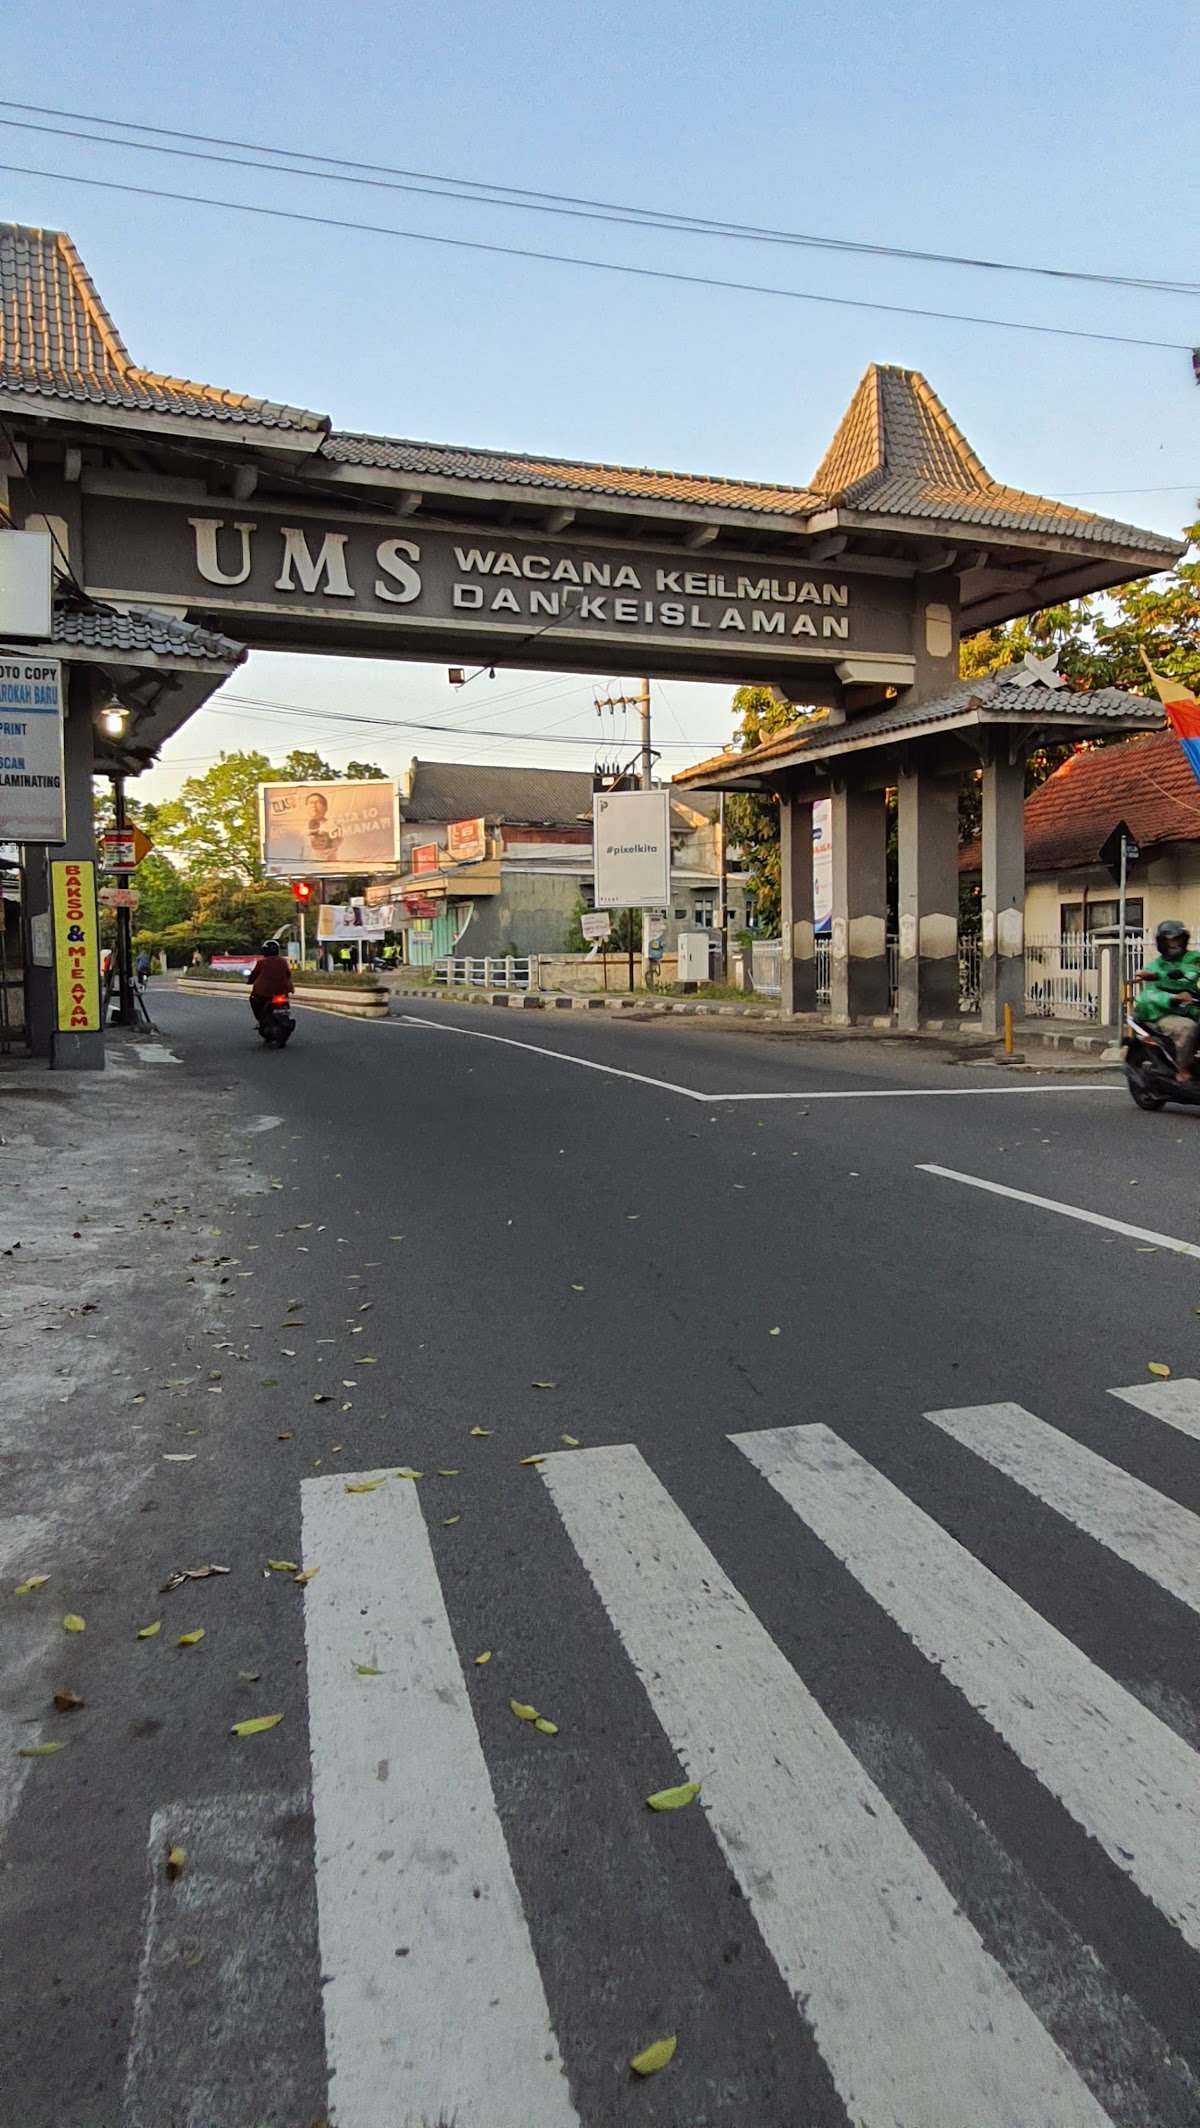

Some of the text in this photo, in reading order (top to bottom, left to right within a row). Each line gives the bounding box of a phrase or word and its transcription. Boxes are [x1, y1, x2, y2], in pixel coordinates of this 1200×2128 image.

[188, 517, 422, 603] UMS
[453, 547, 848, 607] WACANA KEILMUAN
[453, 583, 848, 639] DAN KEISLAMAN
[24, 666, 57, 681] COPY
[34, 686, 58, 705] BARU
[0, 774, 60, 788] LAMINATING
[65, 865, 88, 1027] BAKSO & MIE AYAM
